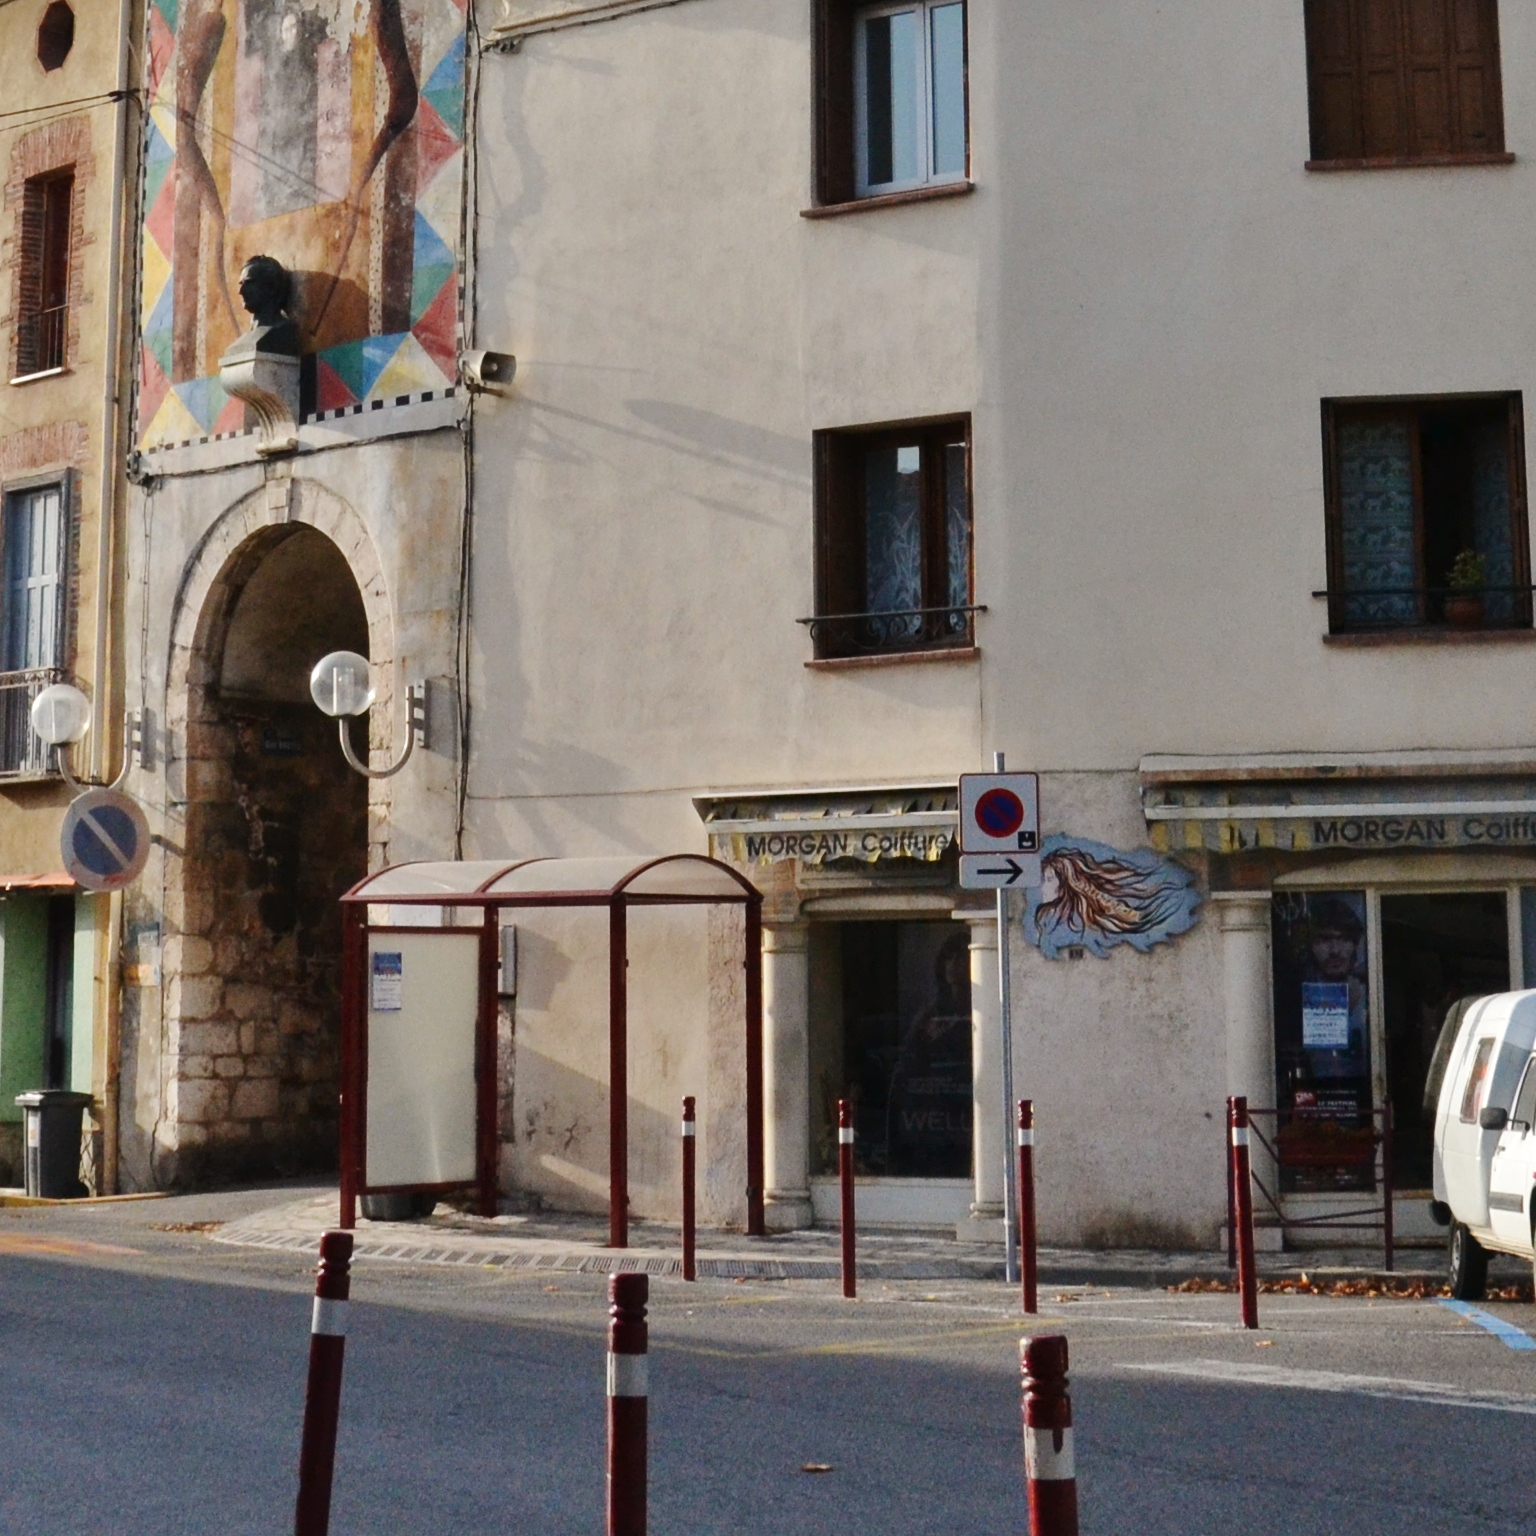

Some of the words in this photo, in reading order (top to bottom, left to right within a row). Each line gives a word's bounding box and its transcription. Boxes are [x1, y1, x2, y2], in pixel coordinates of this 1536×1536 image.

[746, 833, 848, 857] MORGAN
[862, 830, 950, 854] Coiffure
[1313, 819, 1446, 843] MORGAN
